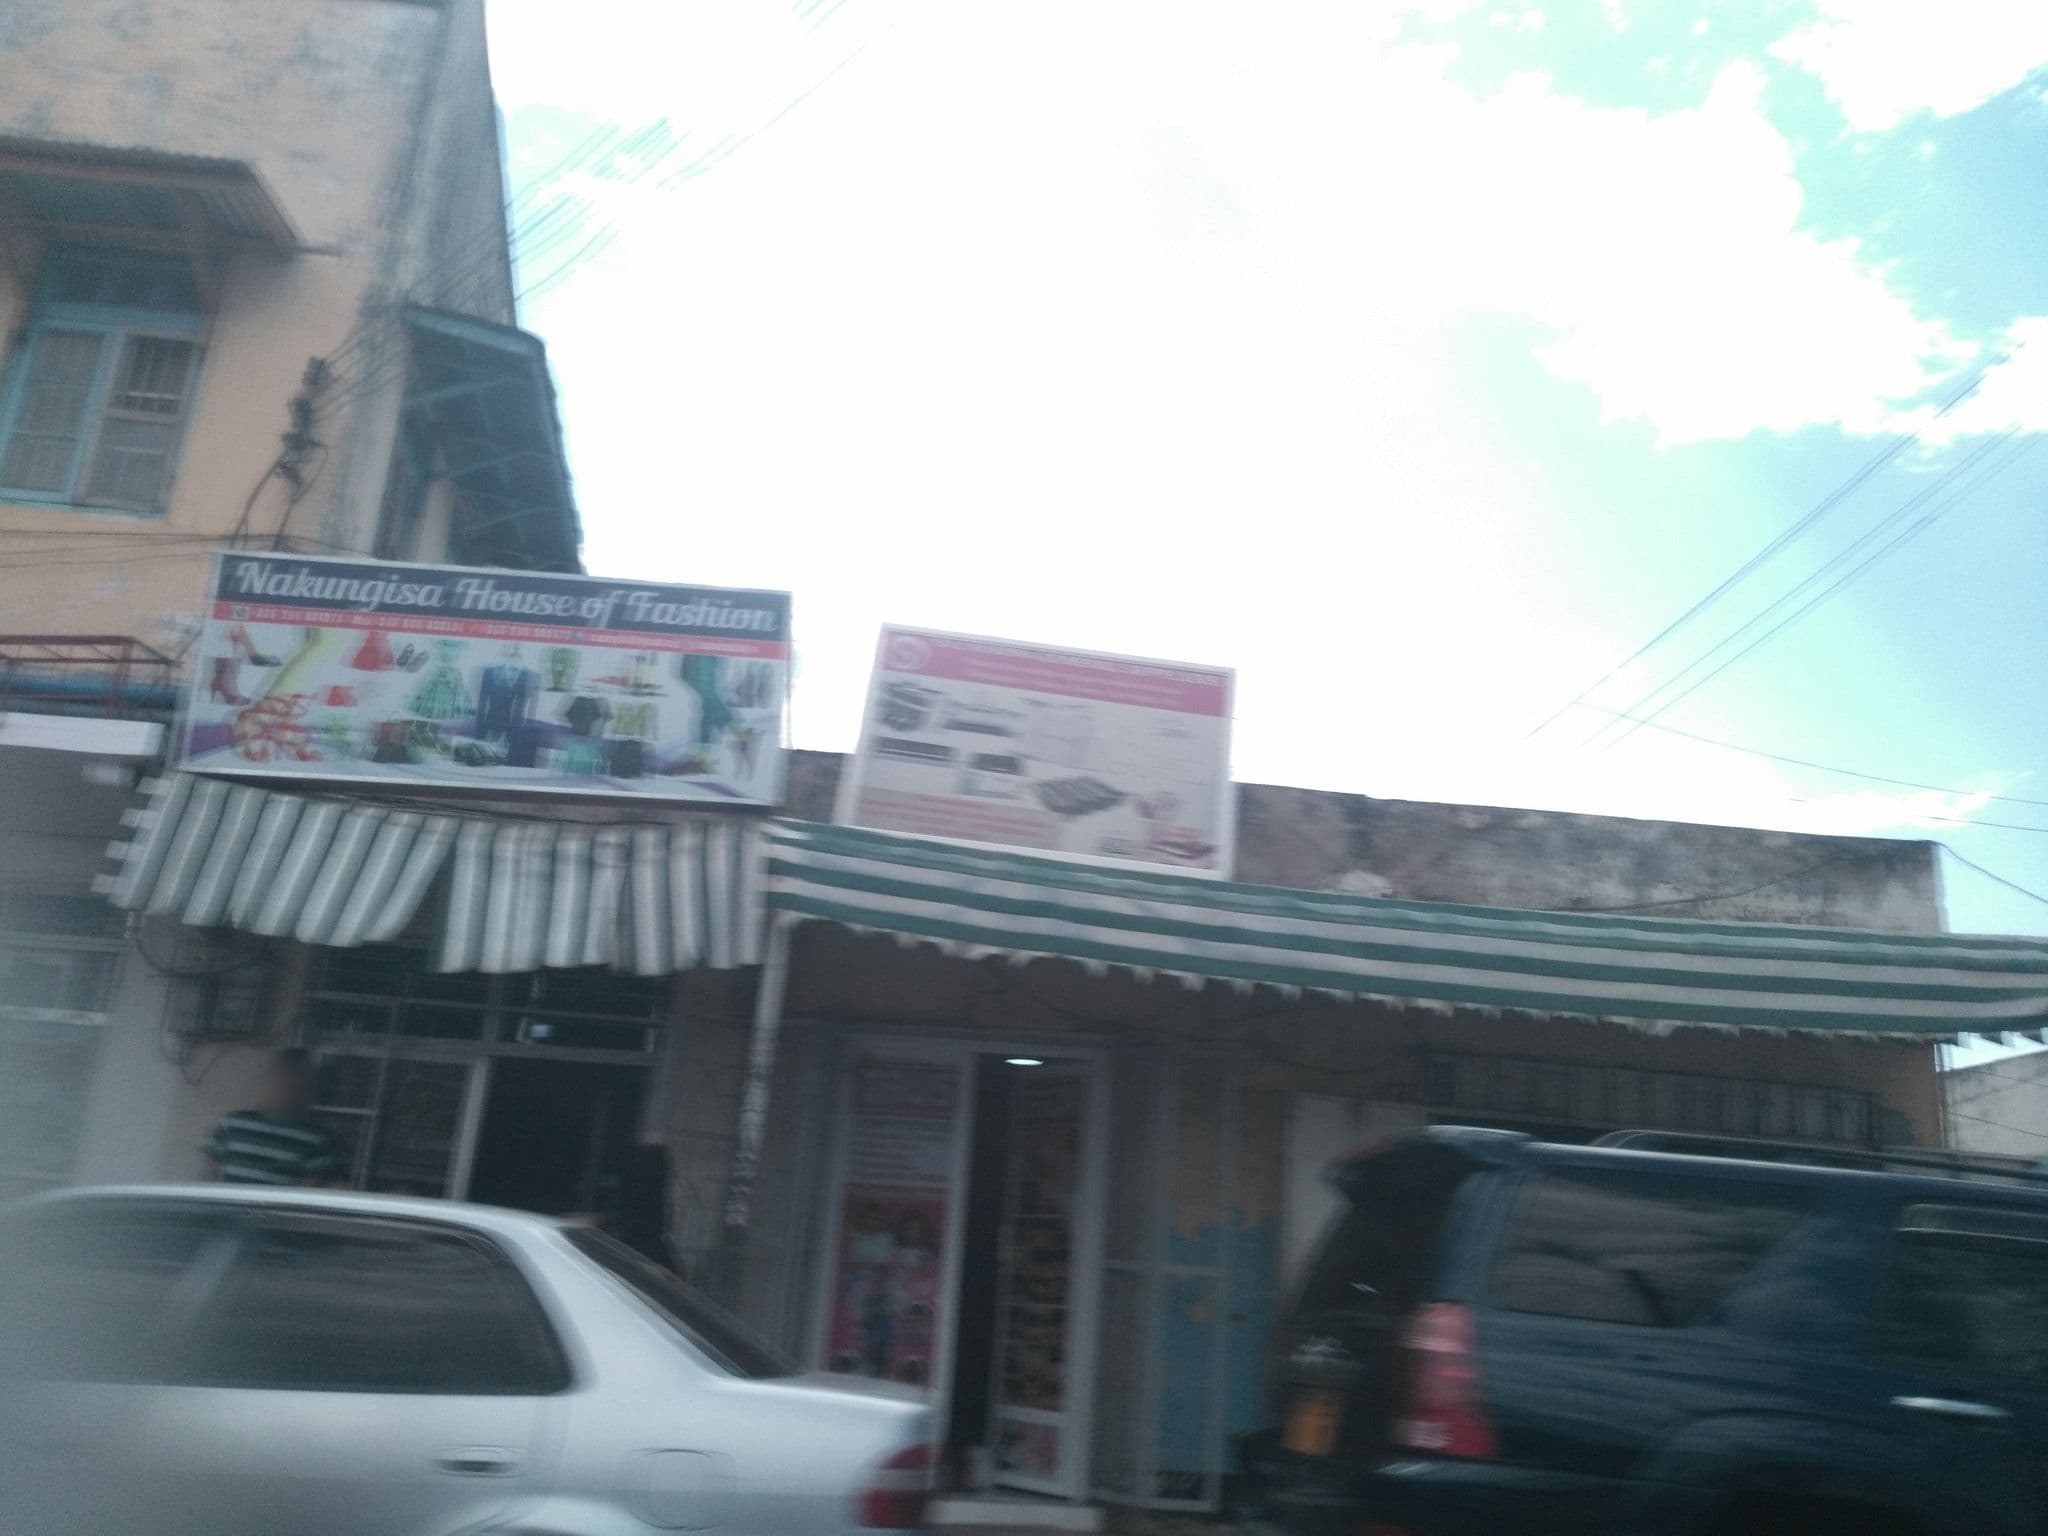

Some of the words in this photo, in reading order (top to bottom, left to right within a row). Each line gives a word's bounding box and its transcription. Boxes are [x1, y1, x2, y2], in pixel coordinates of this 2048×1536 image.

[237, 561, 445, 613] Nakungisa
[456, 578, 576, 617] House
[579, 589, 619, 629] of
[626, 591, 778, 632] Fashion
